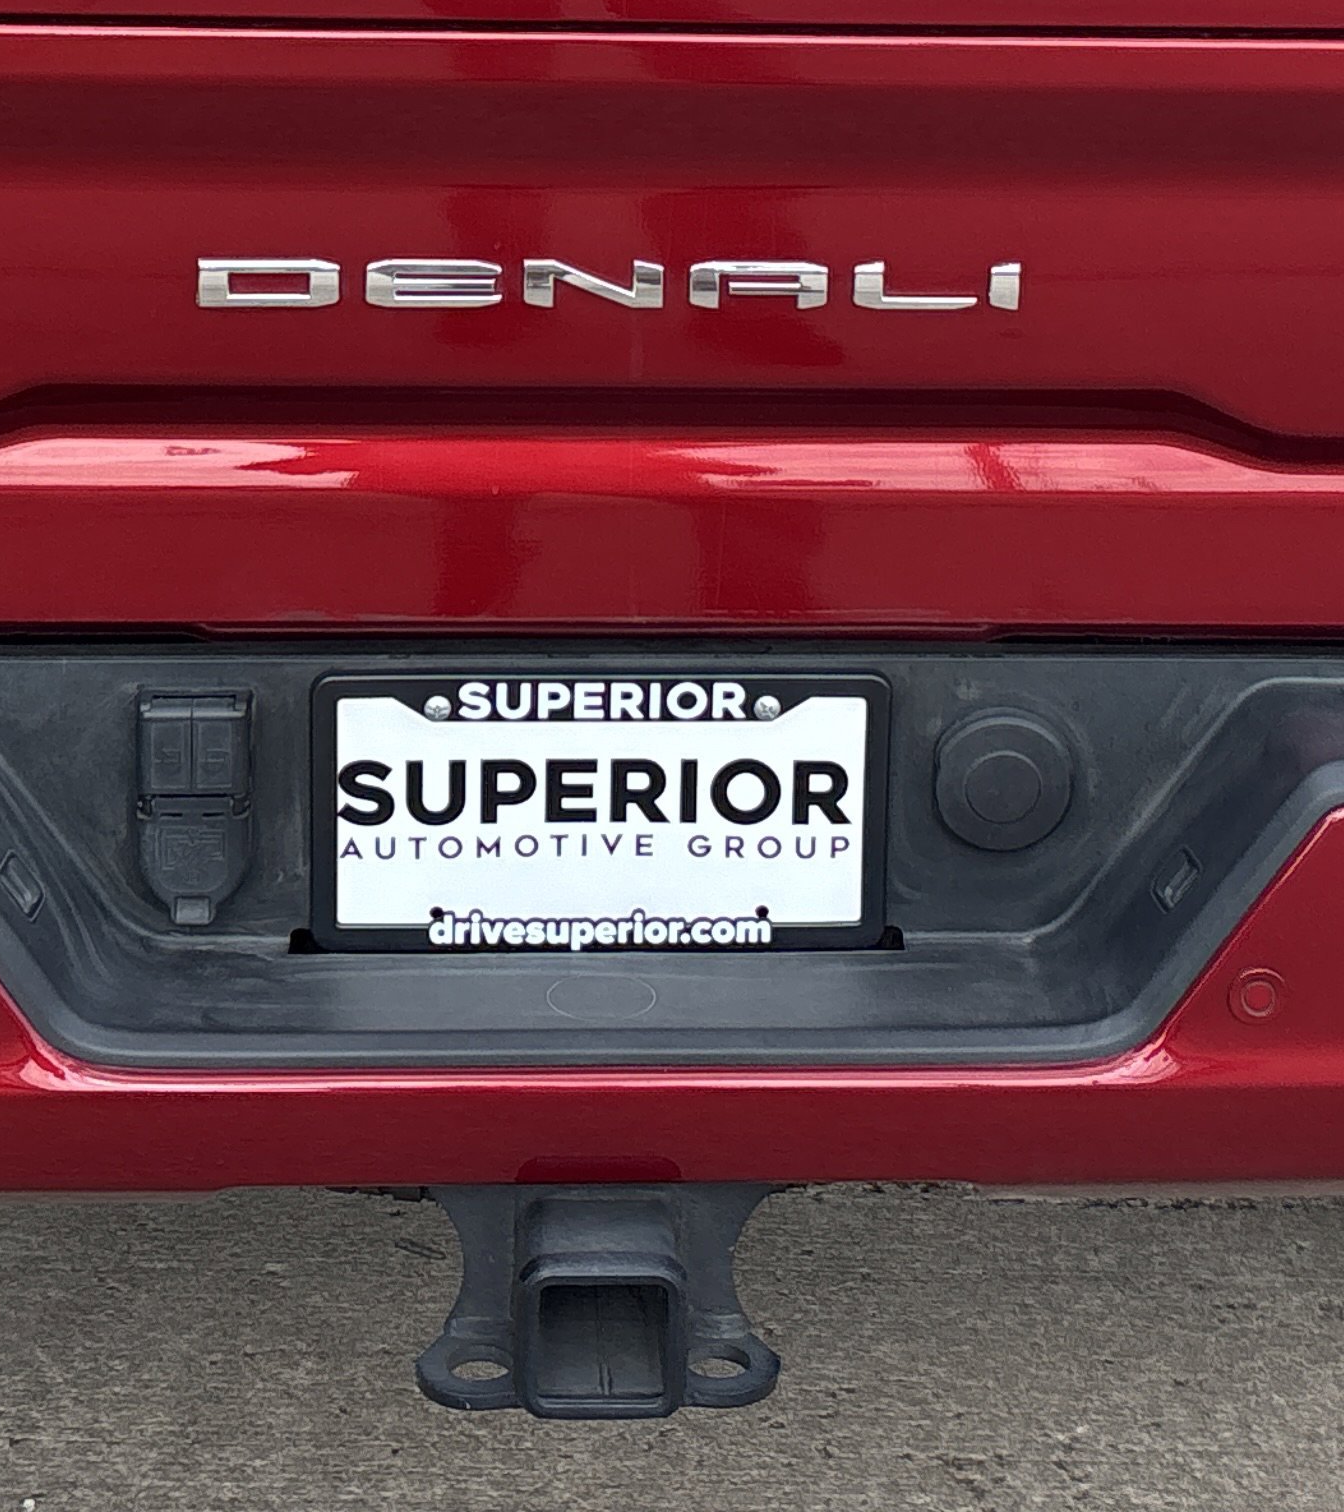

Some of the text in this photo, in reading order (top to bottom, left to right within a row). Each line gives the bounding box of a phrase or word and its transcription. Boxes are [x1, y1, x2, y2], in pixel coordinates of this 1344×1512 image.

[197, 258, 1021, 310] DENALI
[456, 681, 747, 720] SUPERIOR
[337, 758, 851, 826] SUPERIOR
[340, 834, 850, 860] AUTOMOTIVE GROUP
[429, 911, 773, 951] drivesuperior.com
